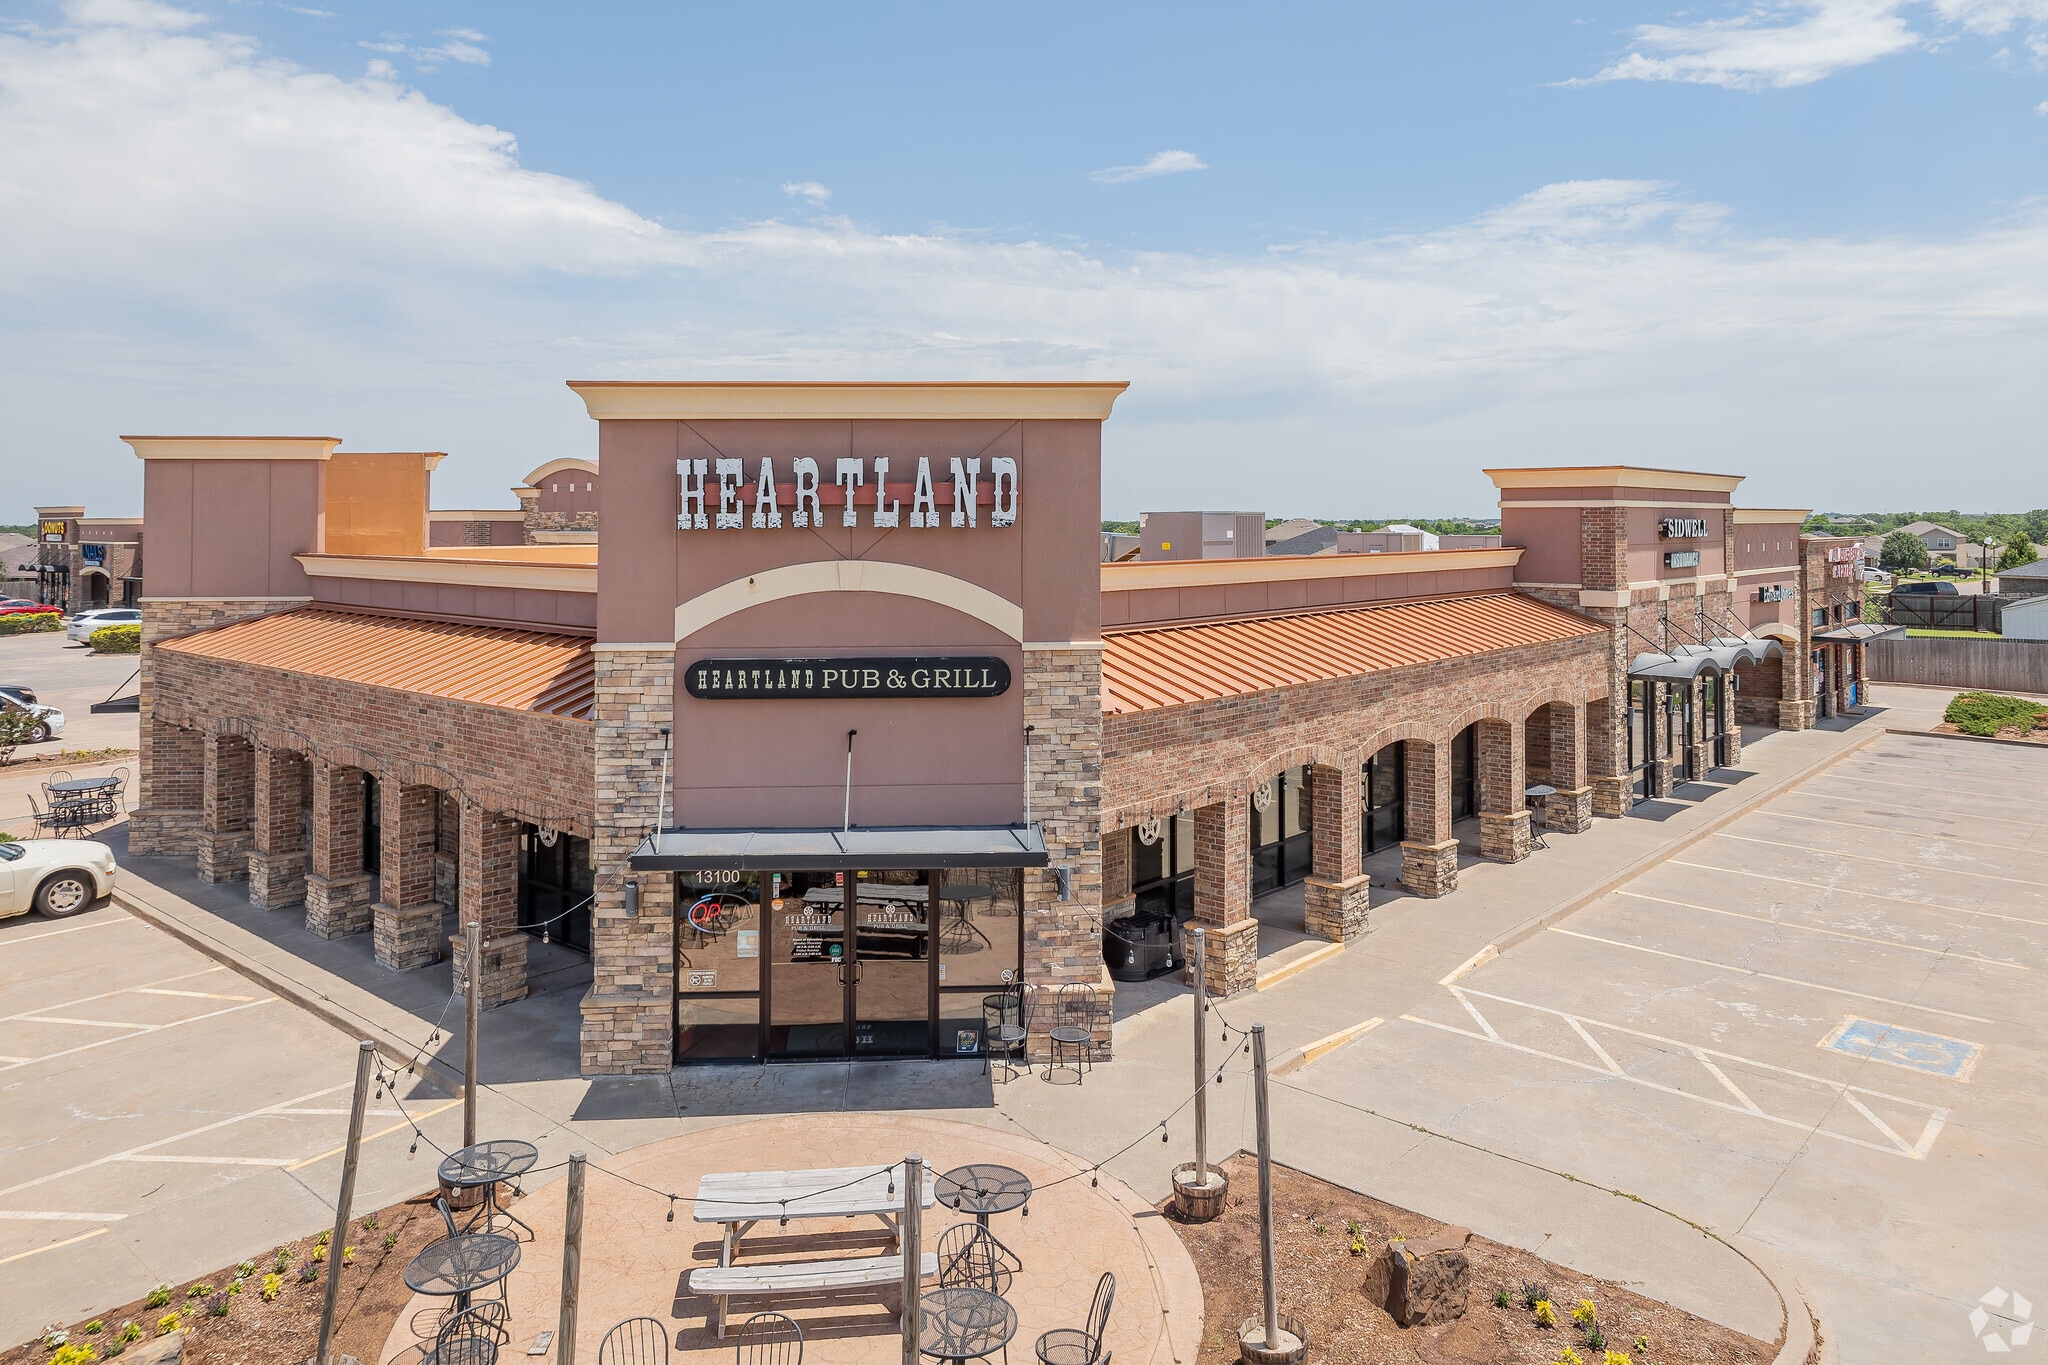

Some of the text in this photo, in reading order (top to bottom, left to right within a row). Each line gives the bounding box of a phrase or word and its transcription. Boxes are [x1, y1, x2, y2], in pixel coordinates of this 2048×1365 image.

[676, 456, 1019, 530] HEARTLAND
[44, 521, 65, 534] DONUTS
[1668, 518, 1708, 538] SIDWELL
[82, 544, 105, 561] NAILS
[697, 668, 997, 690] HEARTLAND PUB & GRILL
[696, 870, 740, 883] 13100
[692, 903, 752, 923] OPEN
[785, 915, 832, 924] HEARTLAND
[867, 913, 914, 922] HEARTLAND
